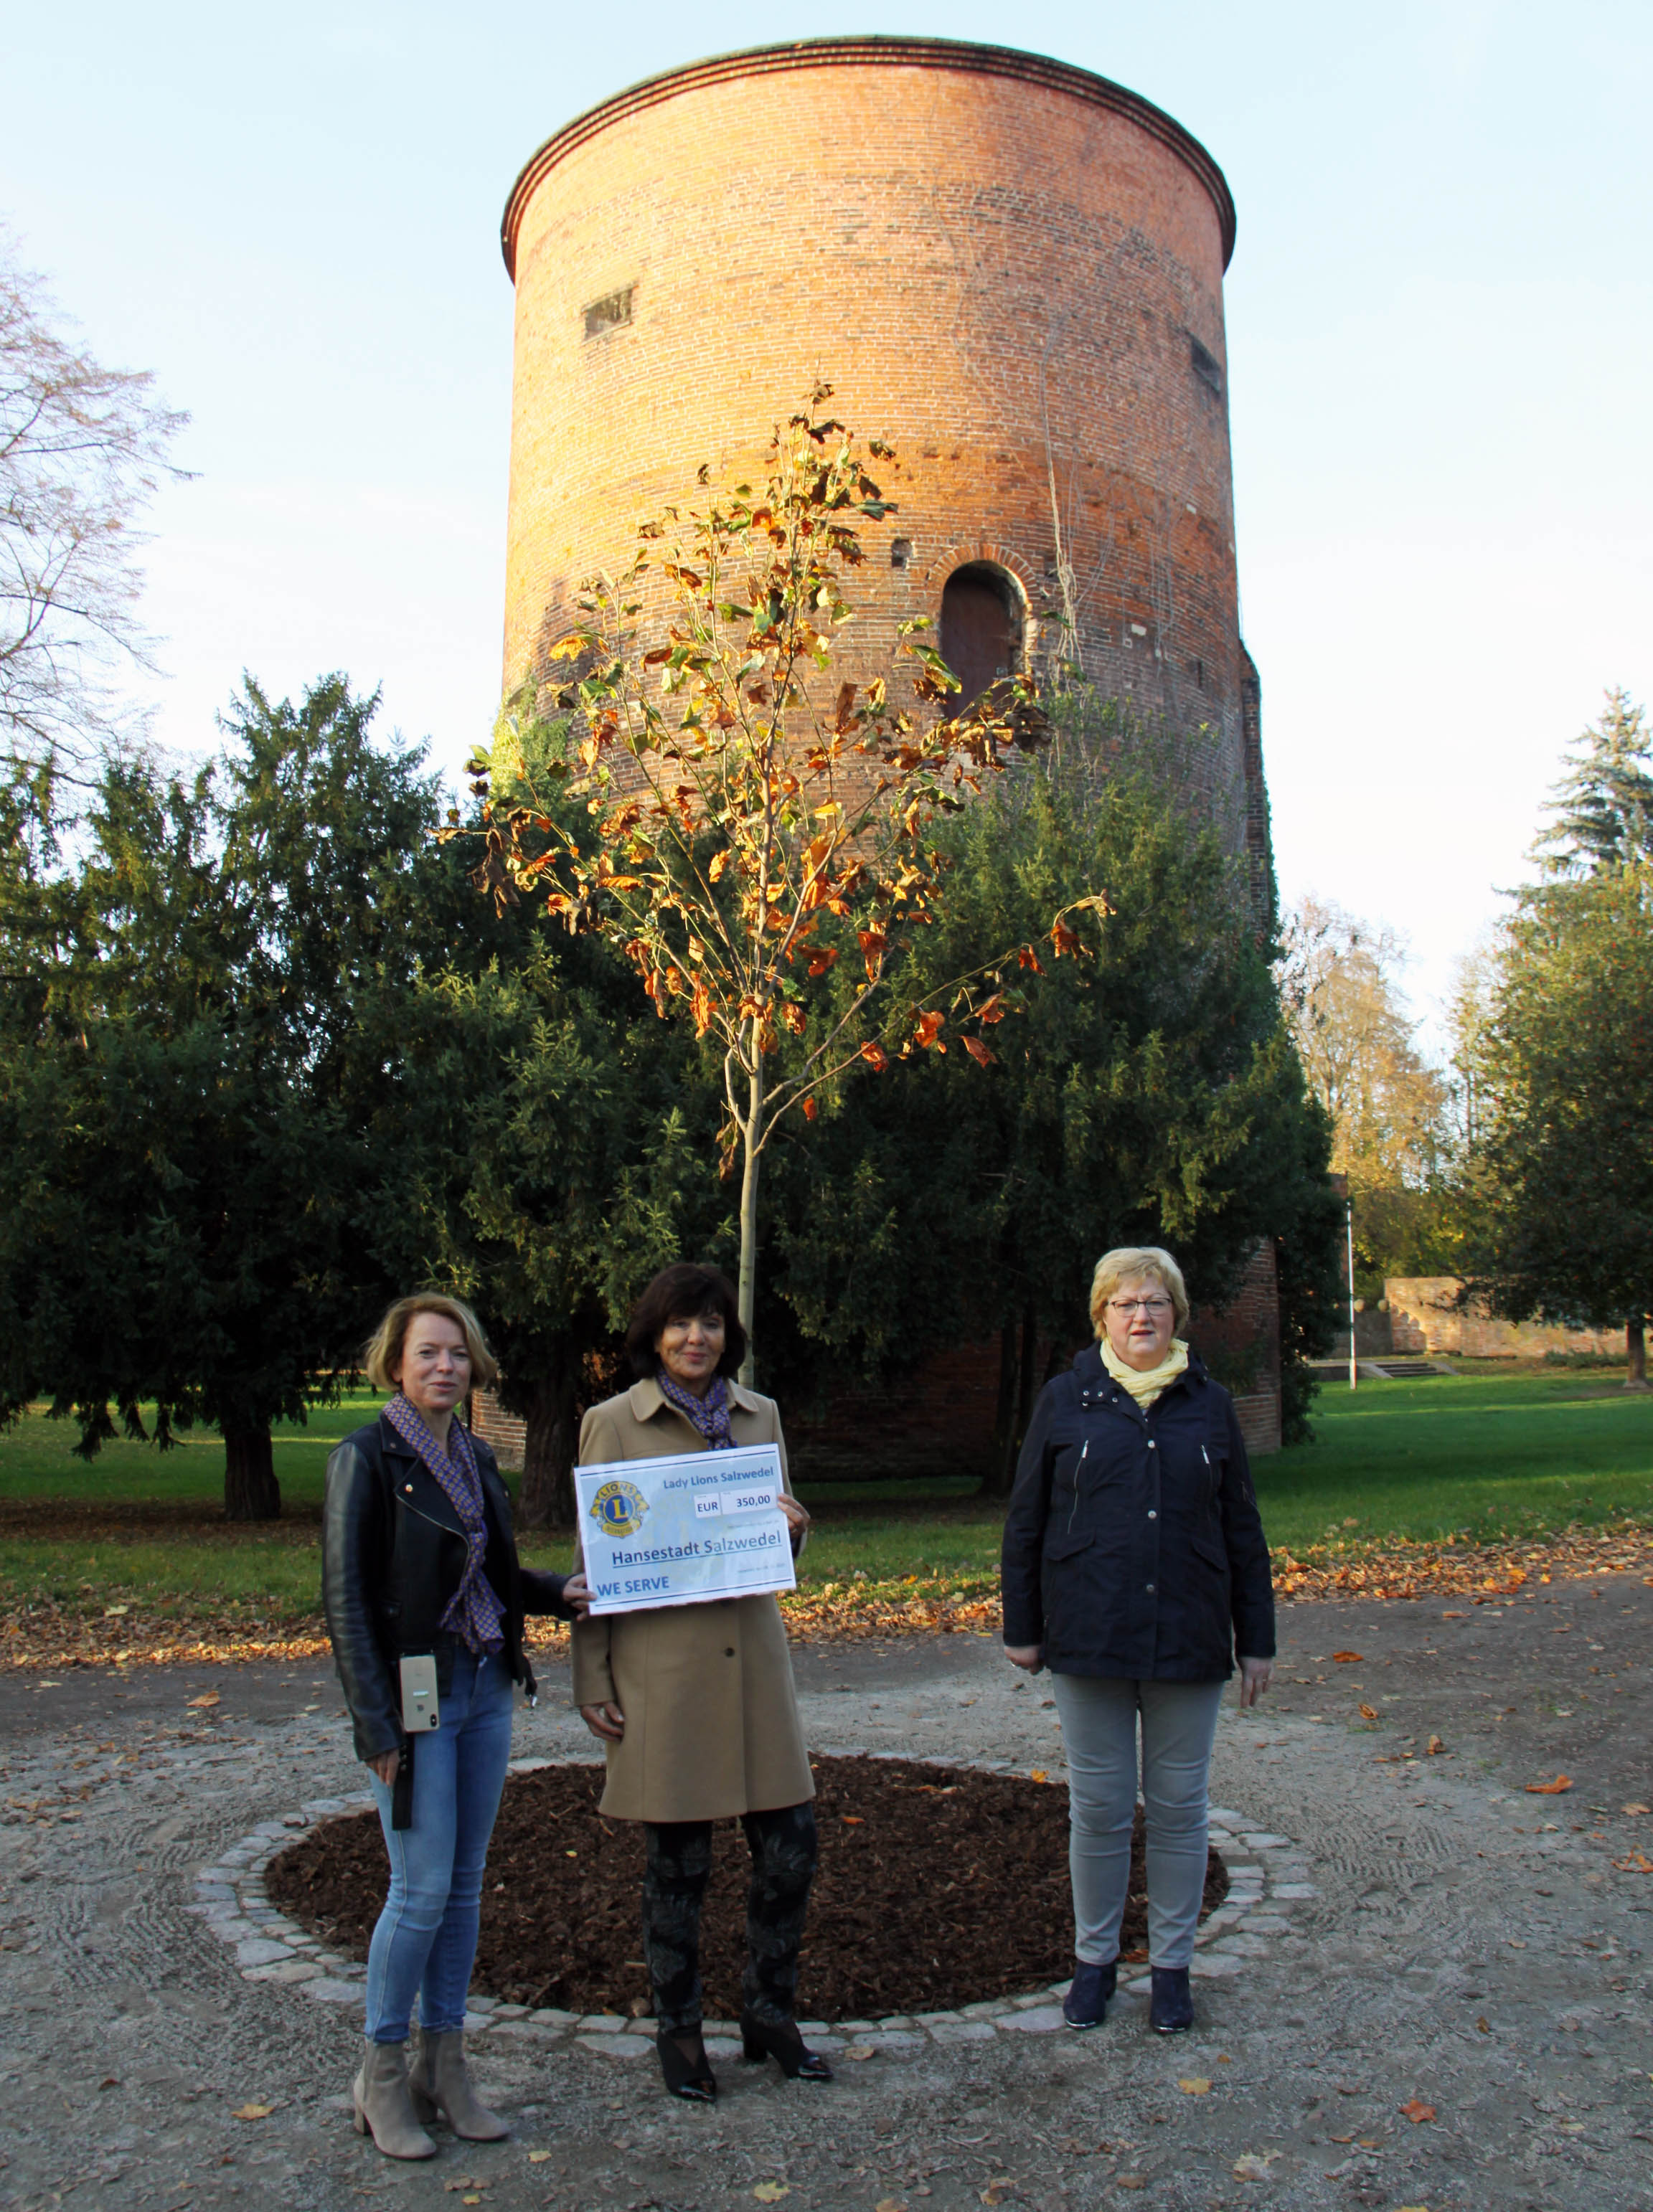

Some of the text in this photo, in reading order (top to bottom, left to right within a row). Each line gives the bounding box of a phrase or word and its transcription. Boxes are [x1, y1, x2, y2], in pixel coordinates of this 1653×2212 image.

[664, 1466, 774, 1489] Lady Lions Salzwedel
[601, 1484, 635, 1497] LIONS
[612, 1499, 628, 1519] L
[697, 1495, 771, 1512] EUR 350,00
[612, 1530, 781, 1565] Hansestadt Salzwedel
[597, 1577, 669, 1596] WE SERVE
